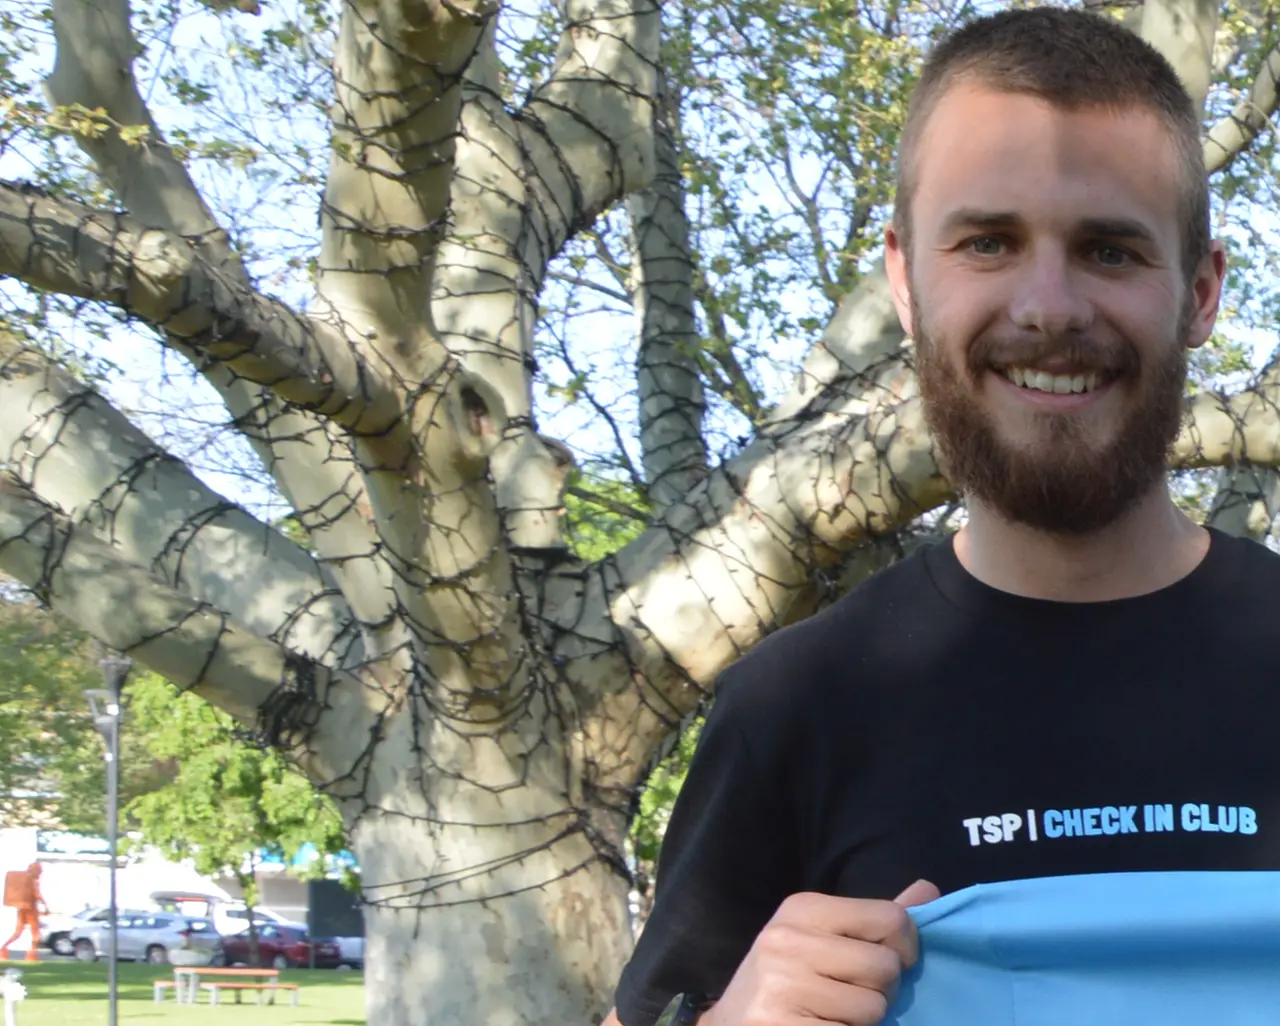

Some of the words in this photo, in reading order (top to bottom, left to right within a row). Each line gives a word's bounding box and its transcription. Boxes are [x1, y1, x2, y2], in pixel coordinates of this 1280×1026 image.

[1043, 804, 1138, 839] CHECK
[1142, 802, 1176, 834] IN
[1179, 801, 1259, 836] CLUB
